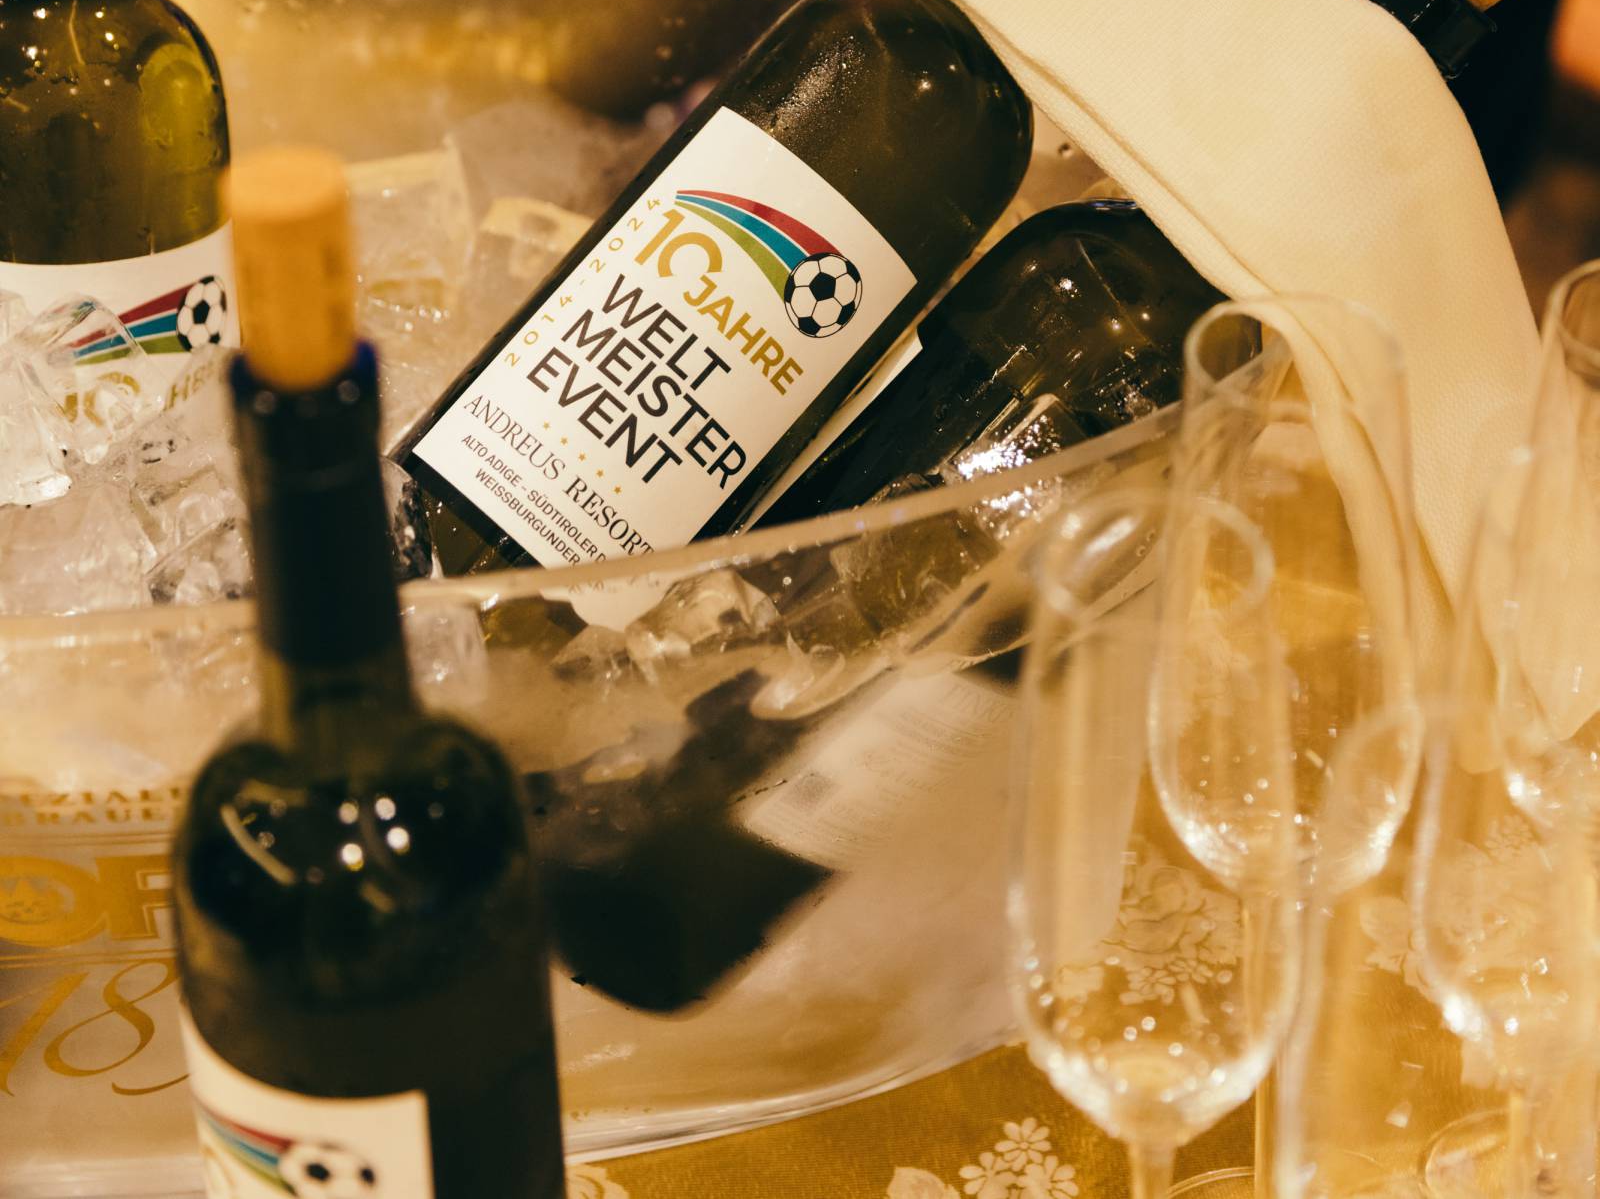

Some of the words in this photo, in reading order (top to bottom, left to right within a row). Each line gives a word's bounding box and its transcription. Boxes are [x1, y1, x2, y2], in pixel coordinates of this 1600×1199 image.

[601, 273, 732, 391] WELT
[633, 208, 723, 278] 10
[682, 273, 804, 396] JAHRE
[463, 395, 566, 481] ANDREUS
[526, 347, 683, 484] EVENT
[560, 308, 747, 490] MEISTER
[461, 434, 489, 458] ALTO
[485, 452, 523, 486] ADIGE
[526, 489, 598, 558] SÜDTIROLER
[475, 467, 581, 568] WEISSBURGUNDER
